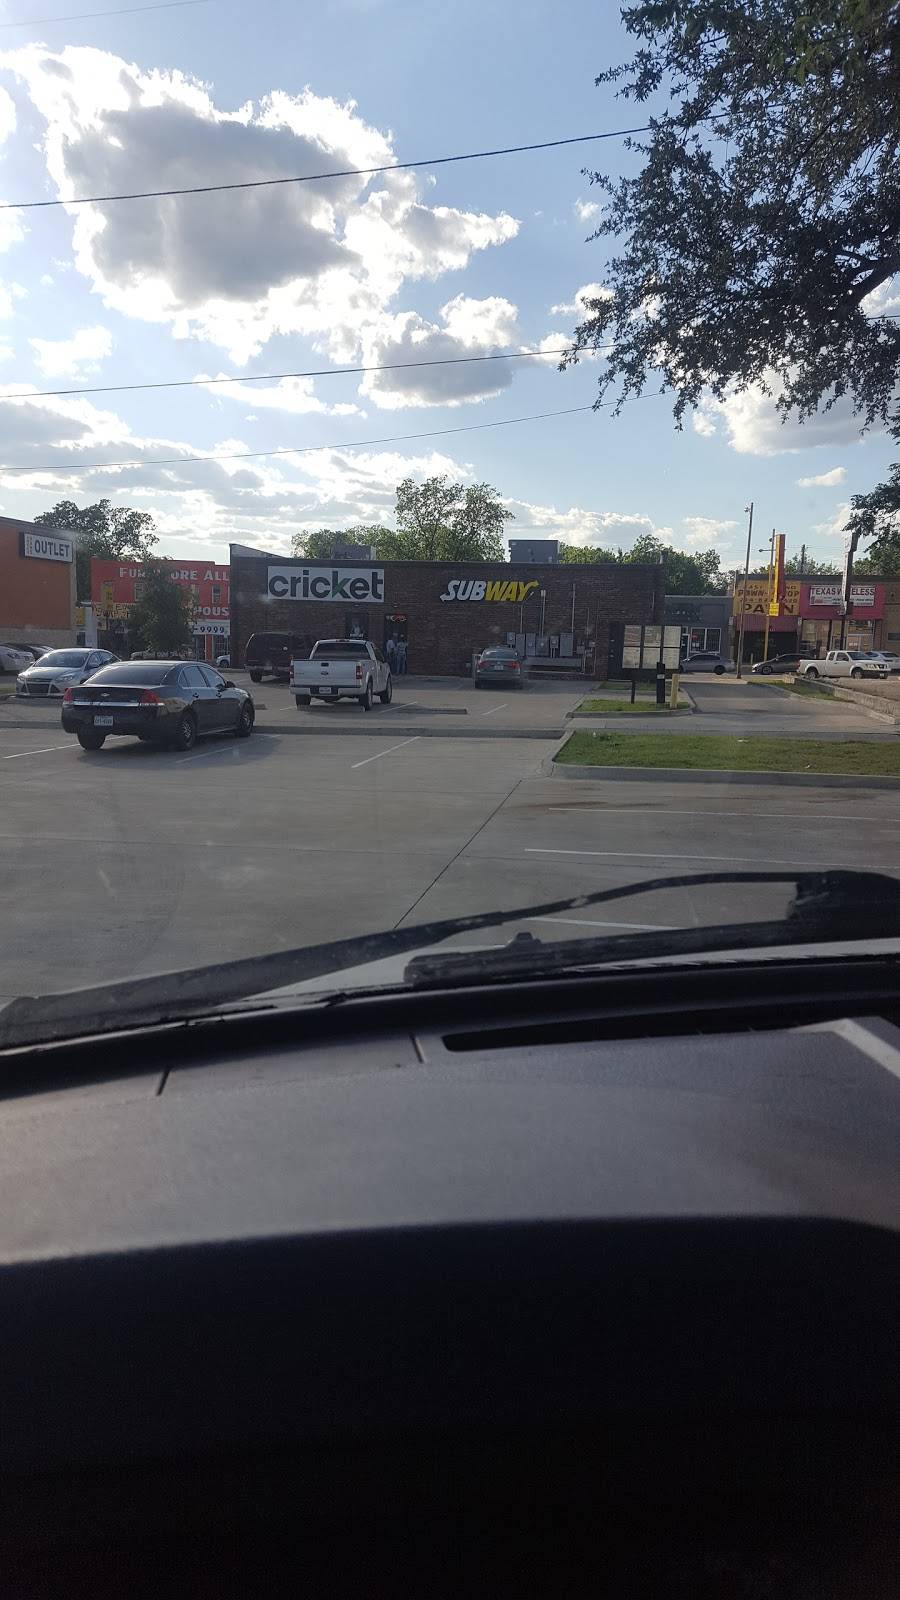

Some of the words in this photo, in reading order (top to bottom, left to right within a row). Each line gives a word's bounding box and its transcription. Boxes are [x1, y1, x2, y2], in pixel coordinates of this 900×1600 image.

[34, 540, 70, 557] OUTLET
[268, 569, 384, 599] cricket
[439, 579, 539, 602] SUBWAY
[811, 587, 836, 595] TEXAS
[837, 587, 875, 596] WELESS
